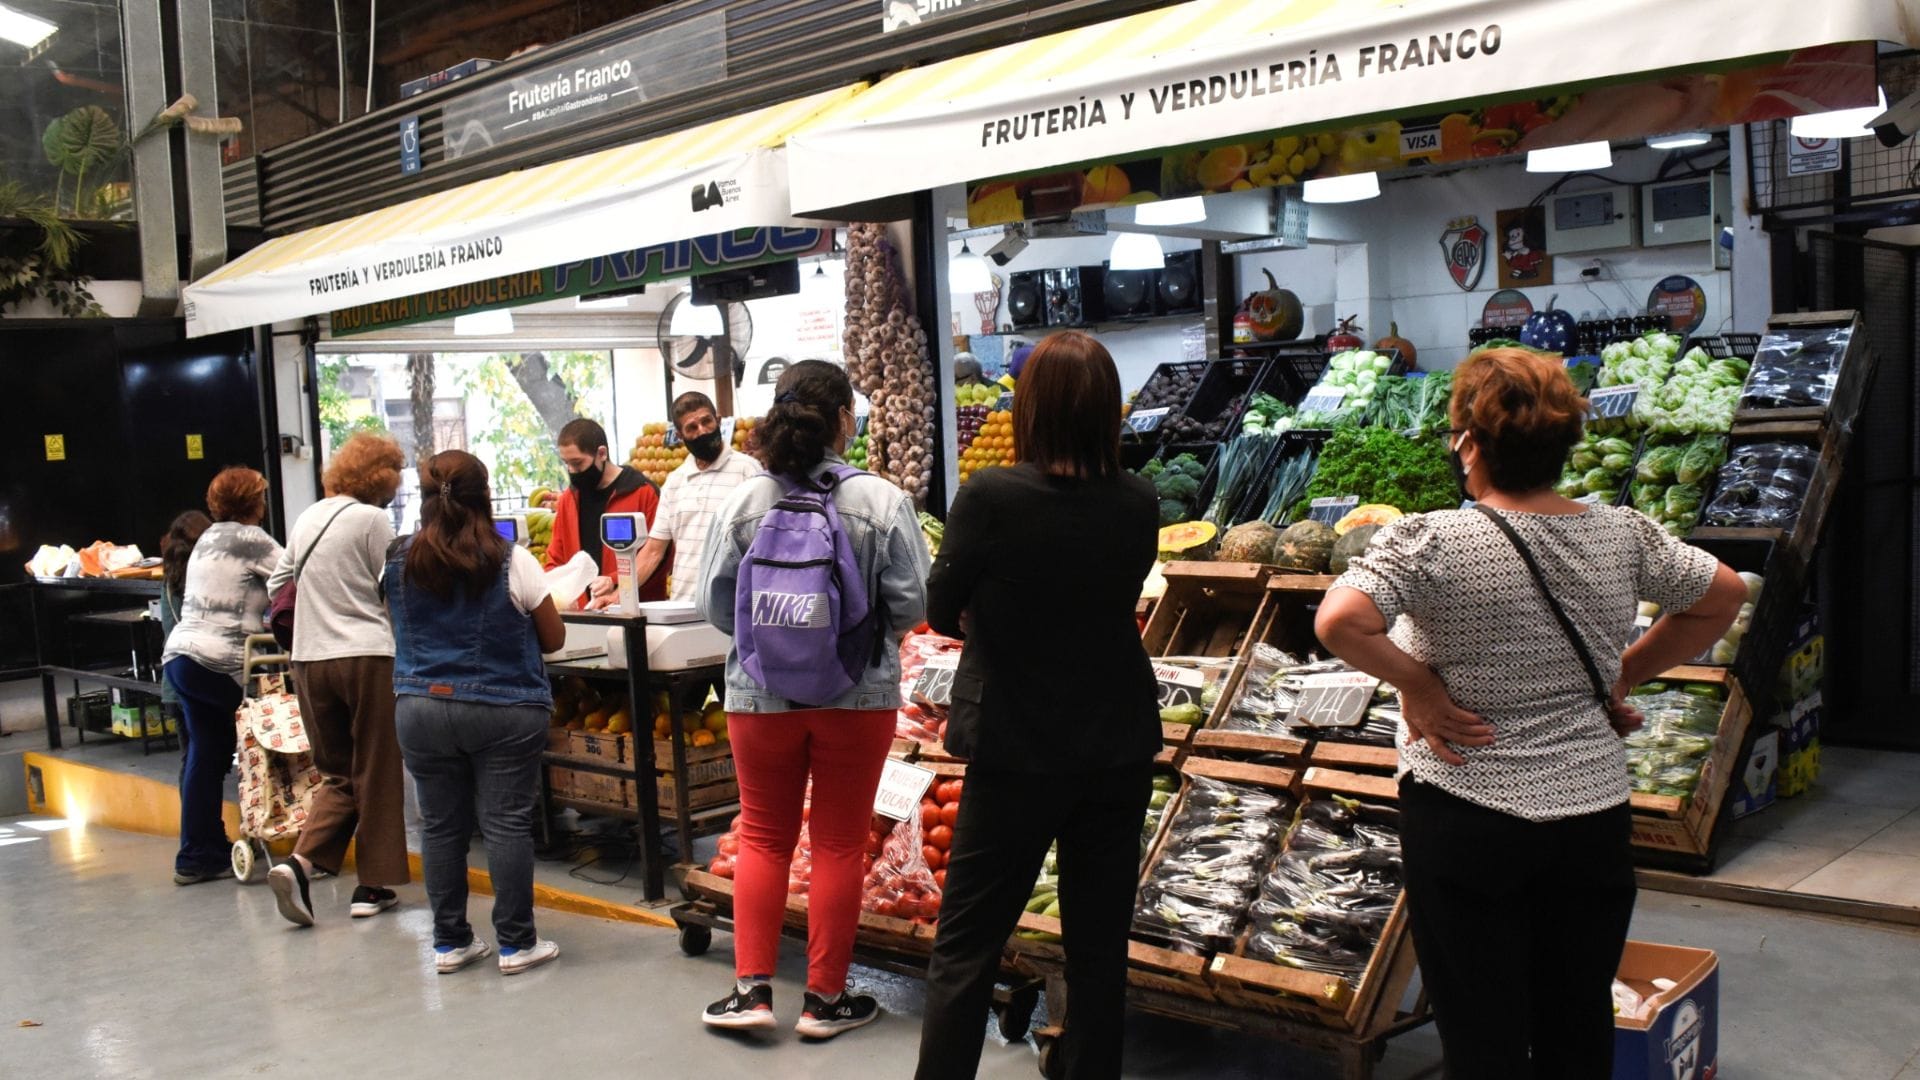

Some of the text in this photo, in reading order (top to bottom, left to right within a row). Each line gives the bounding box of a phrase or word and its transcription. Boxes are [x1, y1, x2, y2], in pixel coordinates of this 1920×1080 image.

[508, 59, 633, 115] Frutería Franco
[981, 24, 1502, 148] FRUTERÍA Y VERDULERÍA FRANCO
[1405, 133, 1438, 150] VISA
[309, 236, 503, 297] FRUTERÍA Y VERDULERÍA FRANCO
[752, 591, 818, 628] NIKE
